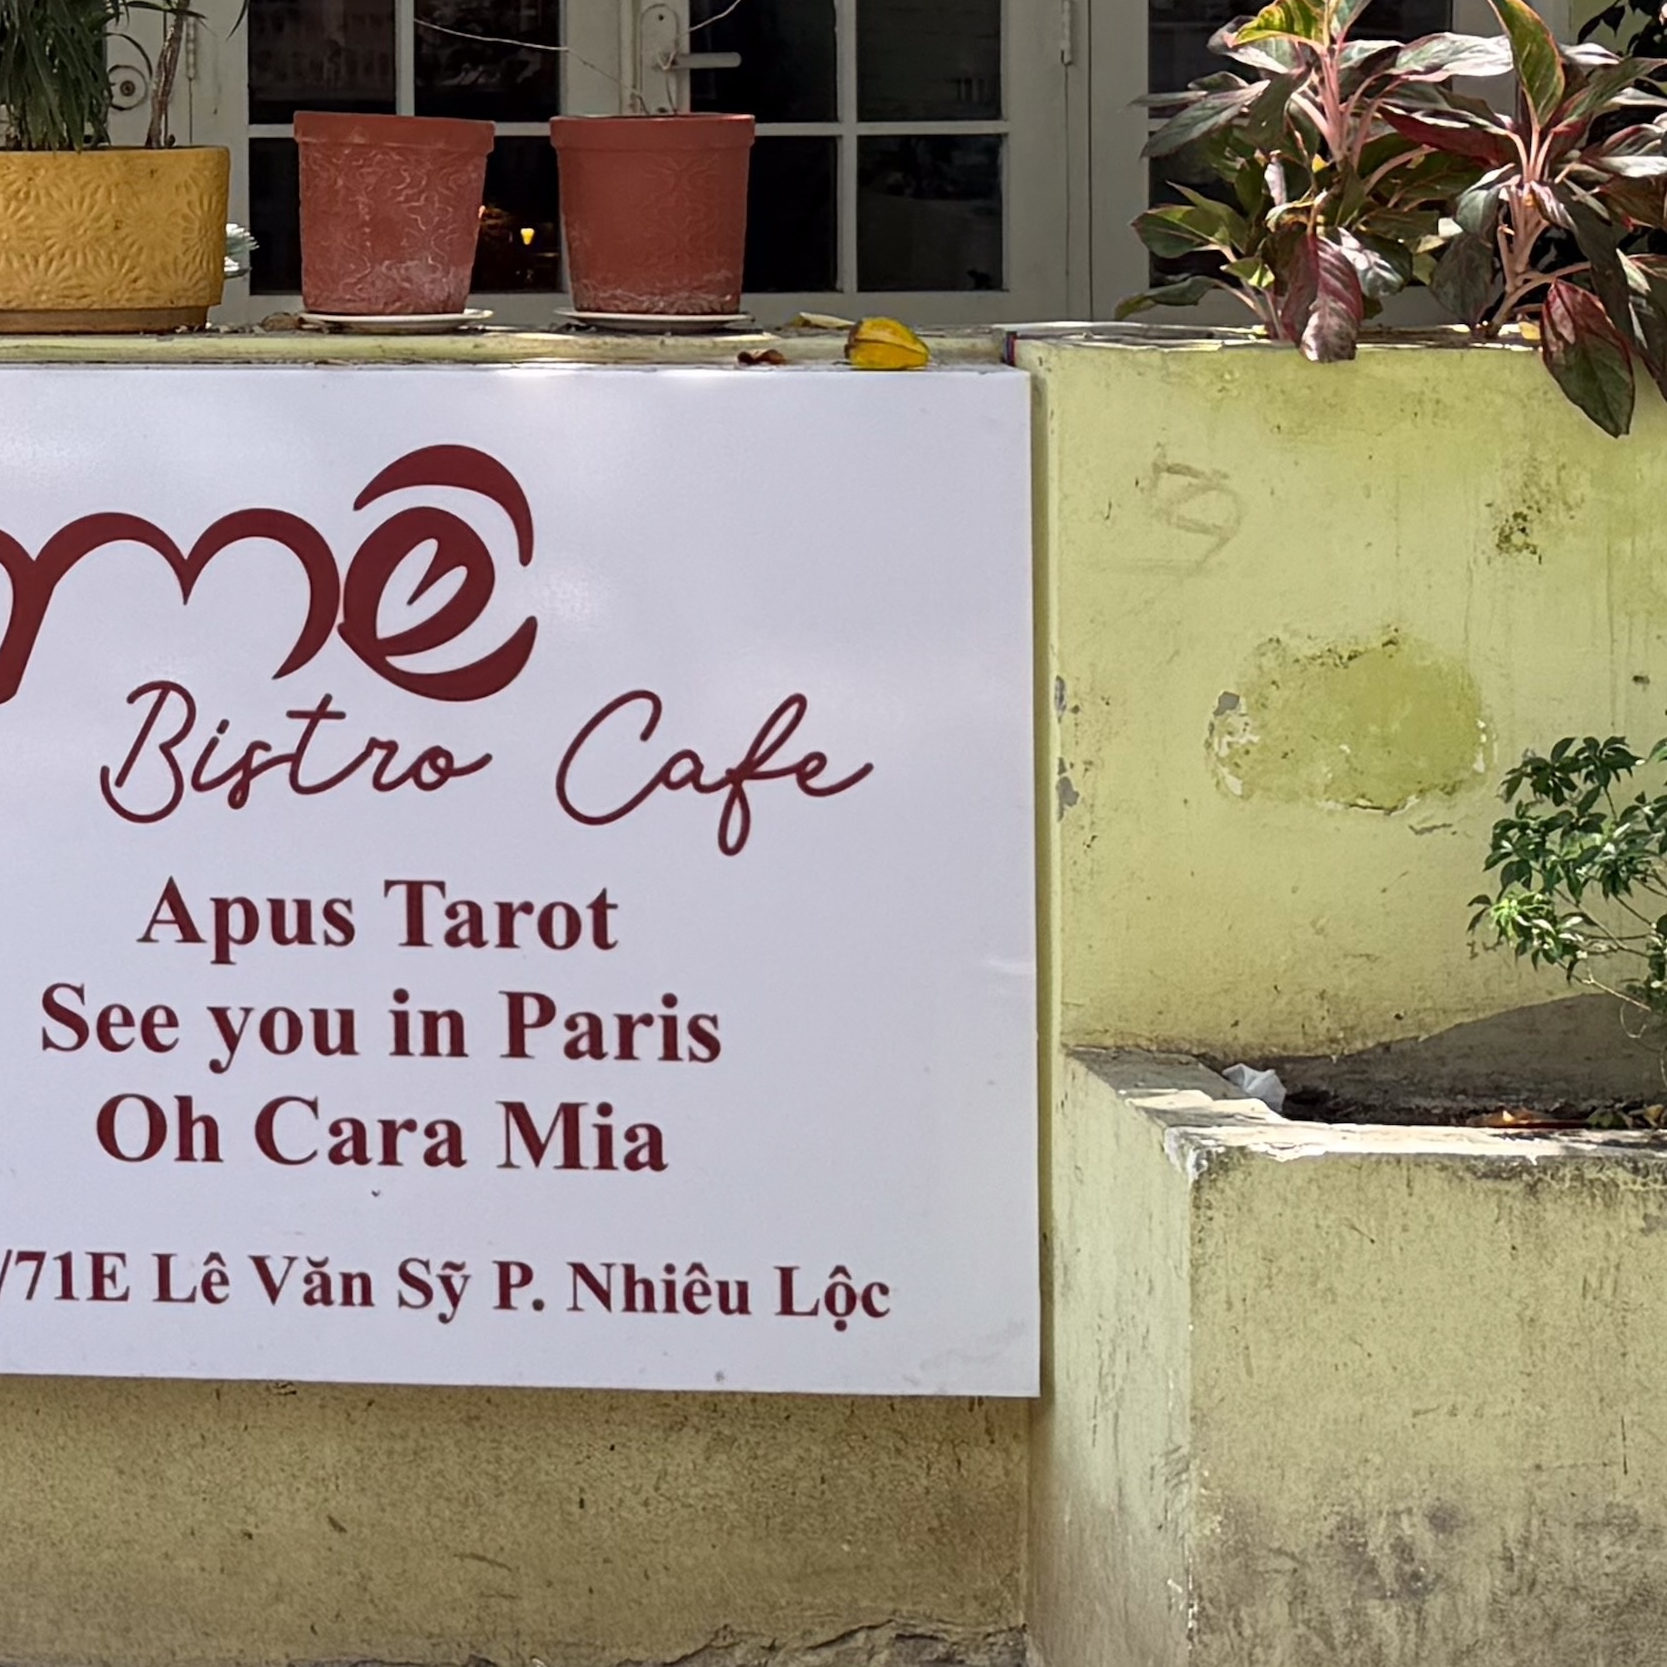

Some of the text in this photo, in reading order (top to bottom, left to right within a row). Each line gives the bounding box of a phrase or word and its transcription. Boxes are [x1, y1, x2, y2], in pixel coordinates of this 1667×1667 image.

[97, 678, 876, 859] Bistro Cafe
[137, 875, 619, 967] Apus Tarot
[39, 980, 724, 1077] See you in Paris
[94, 1091, 670, 1175] Oh Cara Mia
[153, 1251, 232, 1307] Lê
[249, 1253, 376, 1310] Văn
[396, 1257, 468, 1325] Sỹ
[494, 1258, 546, 1313] P.
[568, 1259, 754, 1318] Nhiêu
[775, 1263, 892, 1335] Lộc
